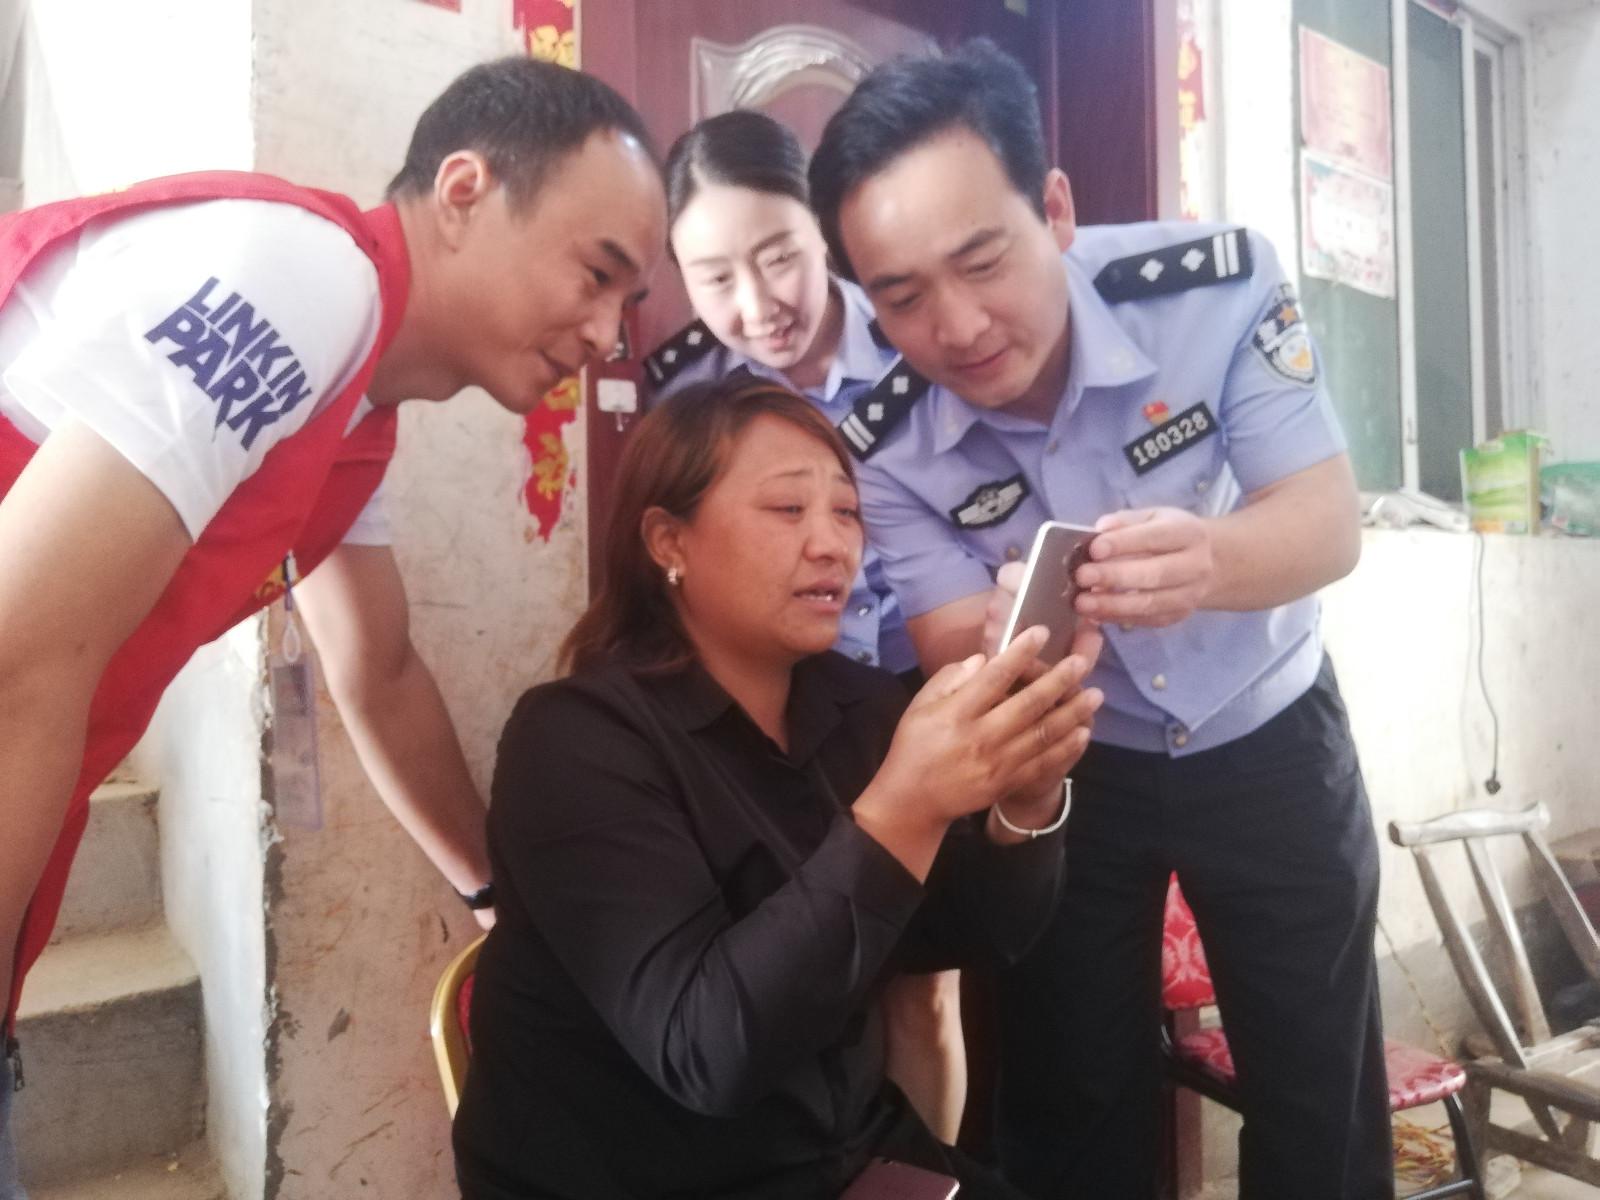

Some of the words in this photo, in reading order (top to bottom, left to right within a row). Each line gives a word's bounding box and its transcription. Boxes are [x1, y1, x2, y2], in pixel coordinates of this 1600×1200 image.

[144, 305, 280, 451] PARK
[184, 276, 312, 414] LINKIN
[1133, 411, 1208, 466] 180328
